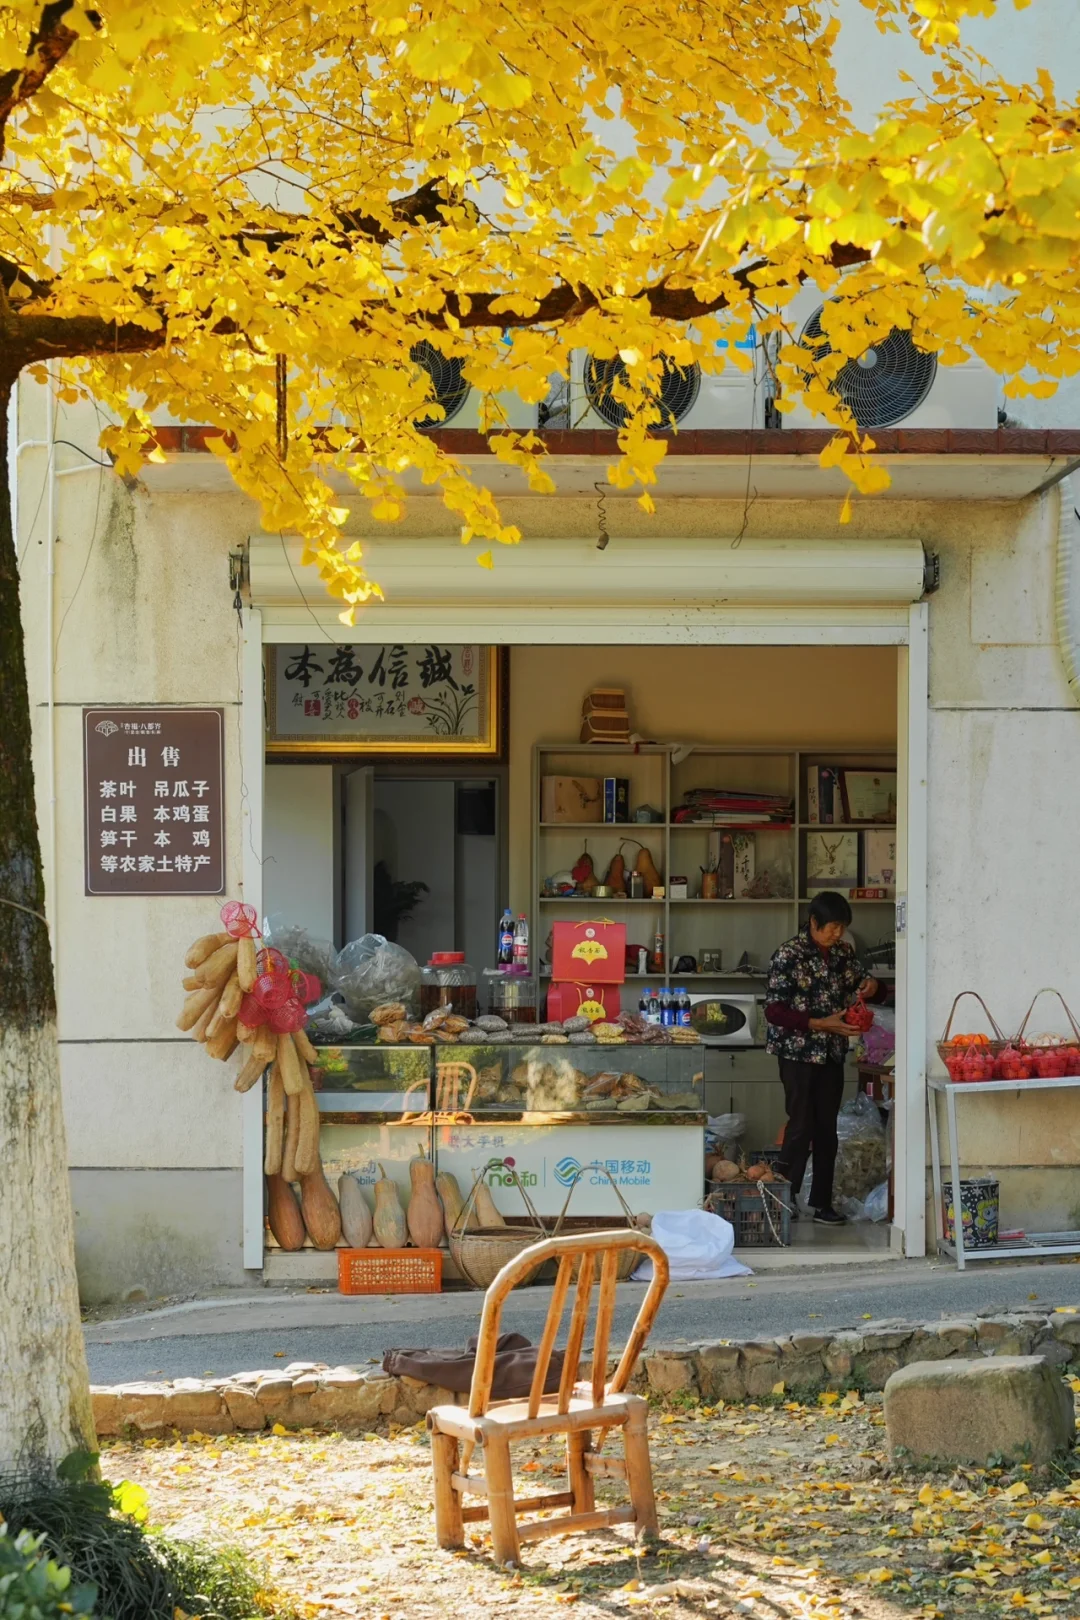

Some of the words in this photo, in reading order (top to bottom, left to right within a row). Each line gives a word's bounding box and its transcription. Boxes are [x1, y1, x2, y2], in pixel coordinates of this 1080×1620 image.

[127, 746, 180, 767] 出售
[99, 780, 136, 798] 茶叶
[154, 780, 209, 798] 吊瓜子
[101, 805, 137, 823] 白果
[153, 805, 209, 823] 本鸡蛋
[100, 830, 137, 848] 笋干
[100, 855, 210, 873] 等农家土特产
[590, 1160, 651, 1174] 中国移动
[589, 1177, 617, 1185] China
[619, 1177, 651, 1185] Mobile
